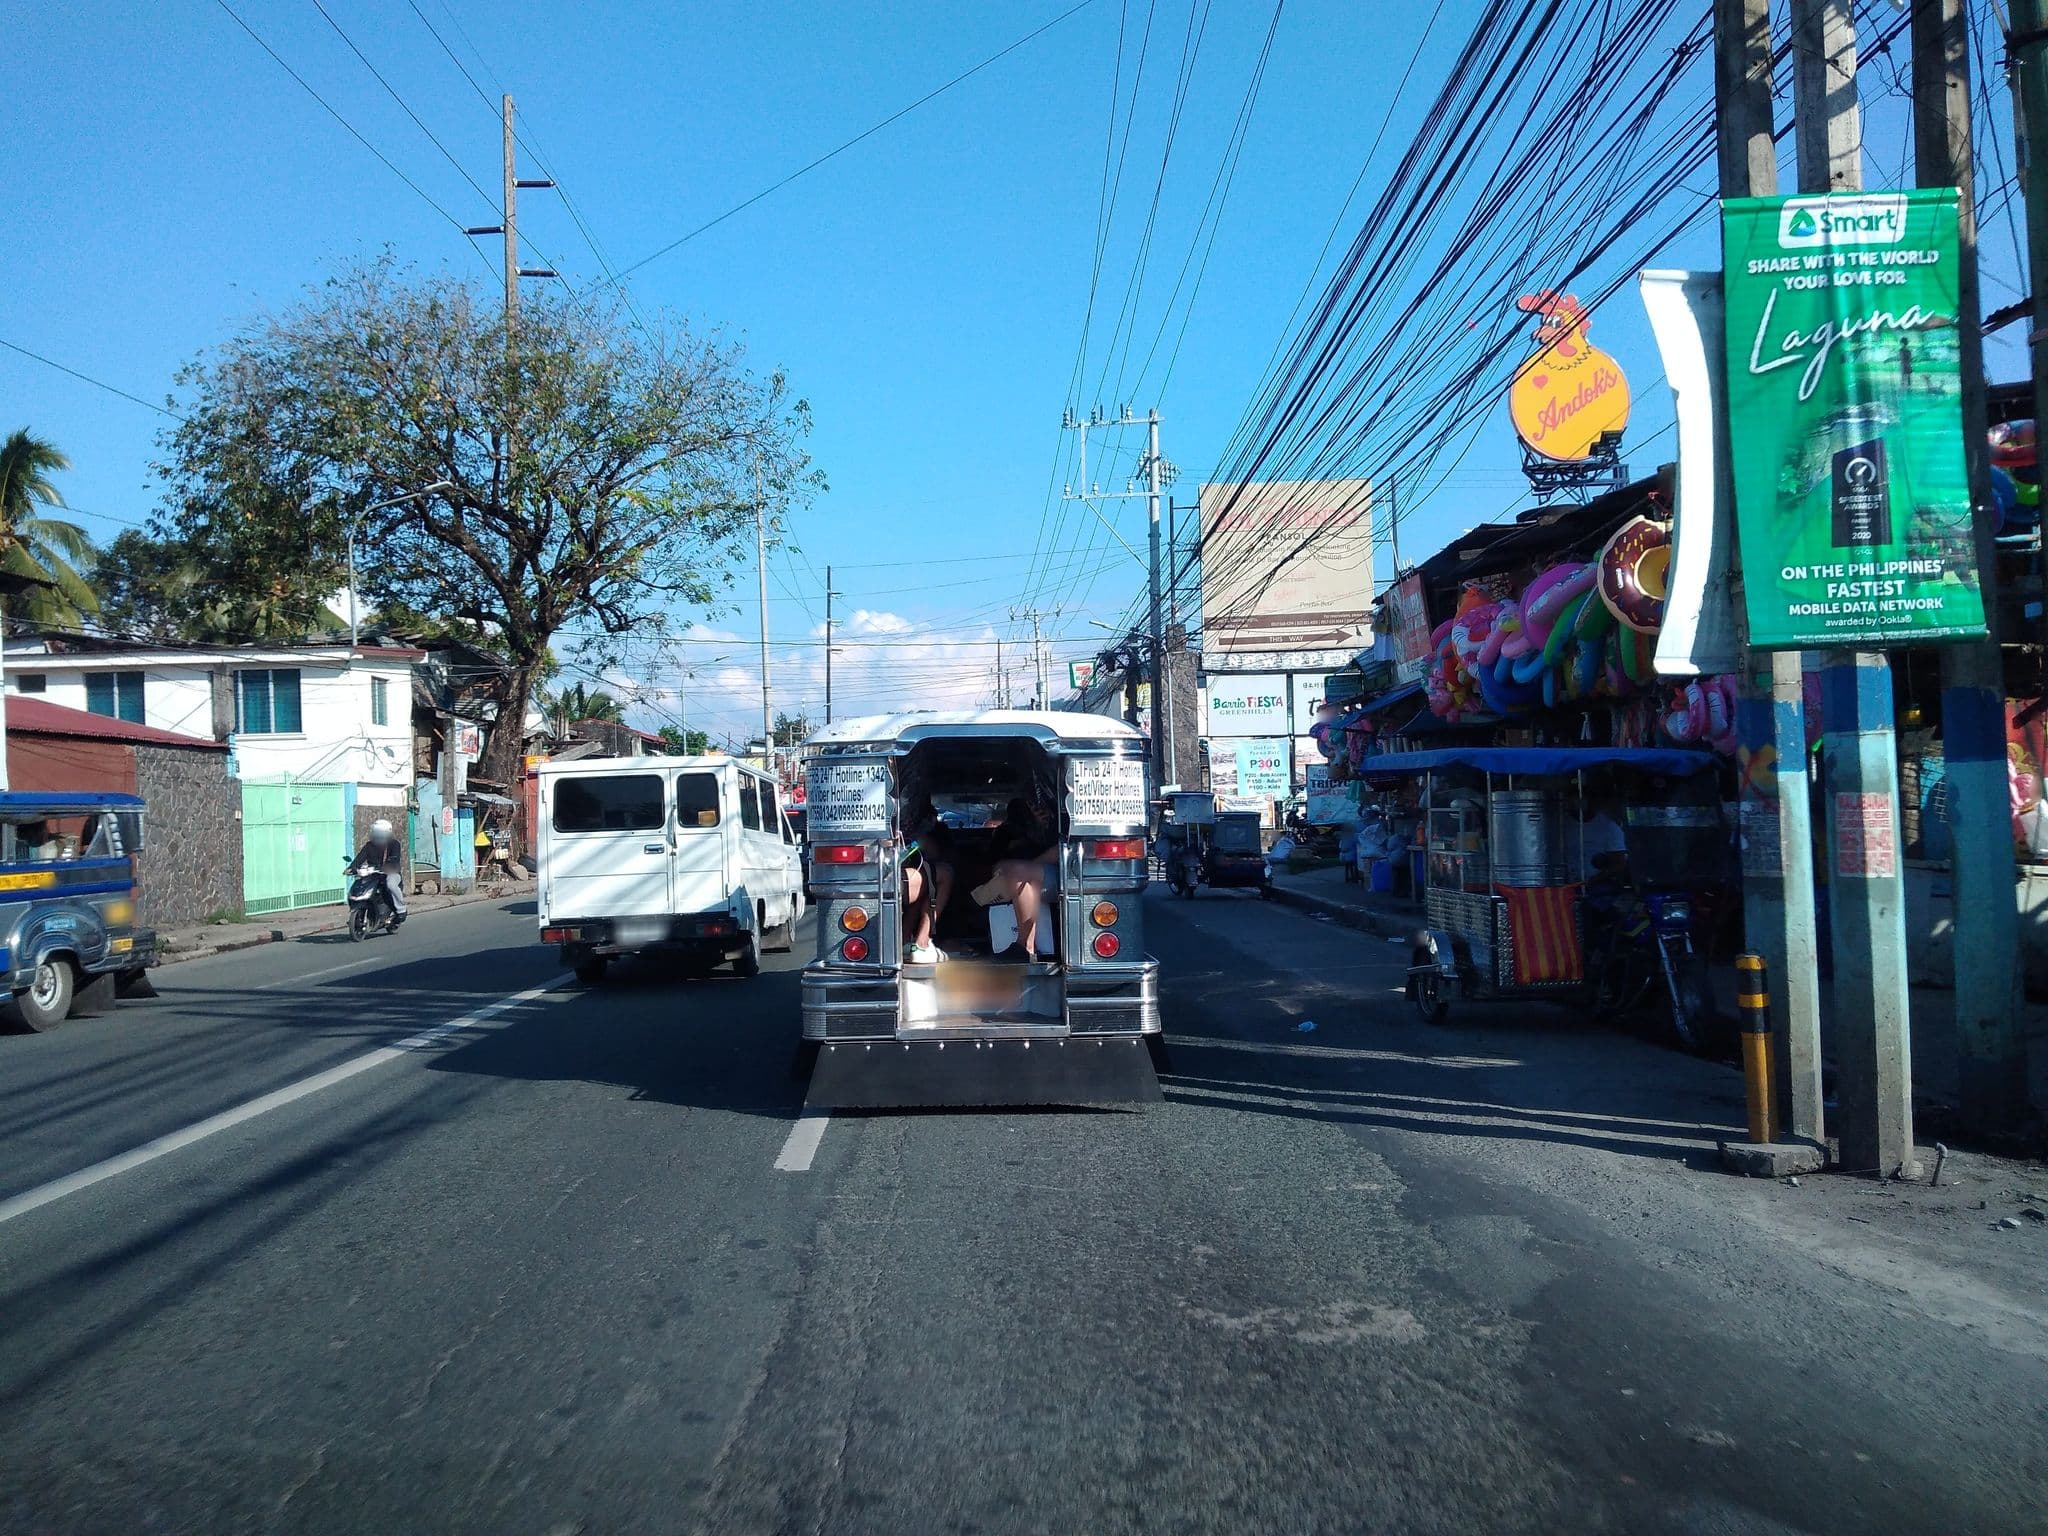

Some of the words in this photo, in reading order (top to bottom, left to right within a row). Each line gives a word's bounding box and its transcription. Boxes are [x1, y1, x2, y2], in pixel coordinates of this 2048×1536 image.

[1820, 209, 1897, 233] Smart
[1748, 256, 1800, 273] SHARE
[1803, 253, 1845, 270] WITH
[1848, 252, 1878, 266] THE
[1881, 250, 1939, 264] WORLD
[1784, 275, 1829, 290] YOUR
[1833, 272, 1872, 286] LOVE
[1875, 270, 1906, 285] FOR
[1749, 287, 1936, 401] Laguna
[1532, 367, 1618, 442] Andok's
[1852, 532, 1872, 540] 2020
[1781, 566, 1807, 580] ON
[1810, 564, 1844, 578] THE
[1848, 559, 1945, 577] PHILIPPINES'
[1827, 580, 1905, 599] FASTEST
[1789, 602, 1841, 616] MOBILE
[1843, 600, 1876, 614] DATA
[1879, 597, 1943, 612] NETWORK
[1825, 616, 1865, 627] awarded
[1866, 616, 1878, 628] by
[1213, 697, 1246, 709] Barrio
[1074, 761, 1100, 778] LTFRB
[1102, 761, 1118, 778] 24/7
[1250, 758, 1281, 768] P300
[836, 766, 865, 783] Hotline:
[867, 766, 885, 782] 1342
[831, 785, 864, 802] Hotlines:
[1074, 779, 1112, 796] Text/Viber
